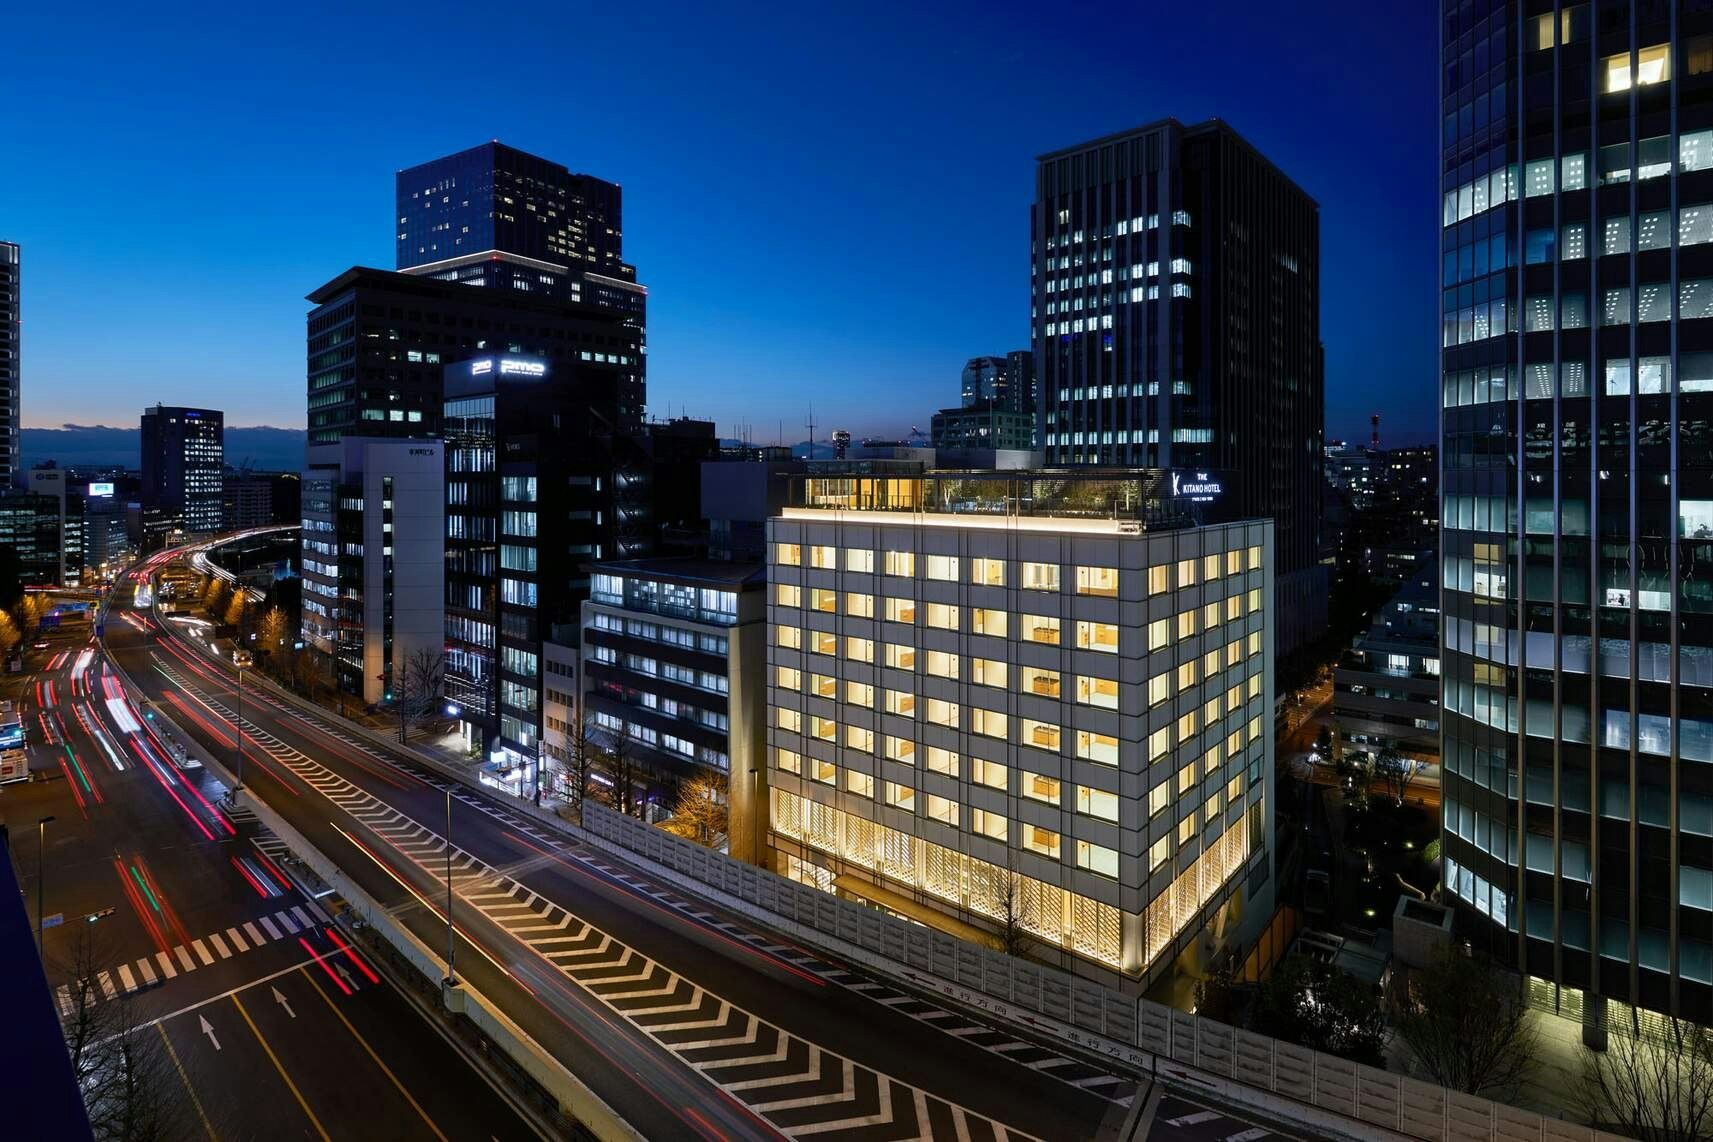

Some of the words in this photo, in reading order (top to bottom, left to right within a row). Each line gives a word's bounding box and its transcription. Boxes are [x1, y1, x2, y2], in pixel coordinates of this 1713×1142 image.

[1197, 473, 1207, 481] THE
[1183, 484, 1203, 493] KITANO
[1204, 483, 1221, 493] HOTEL
